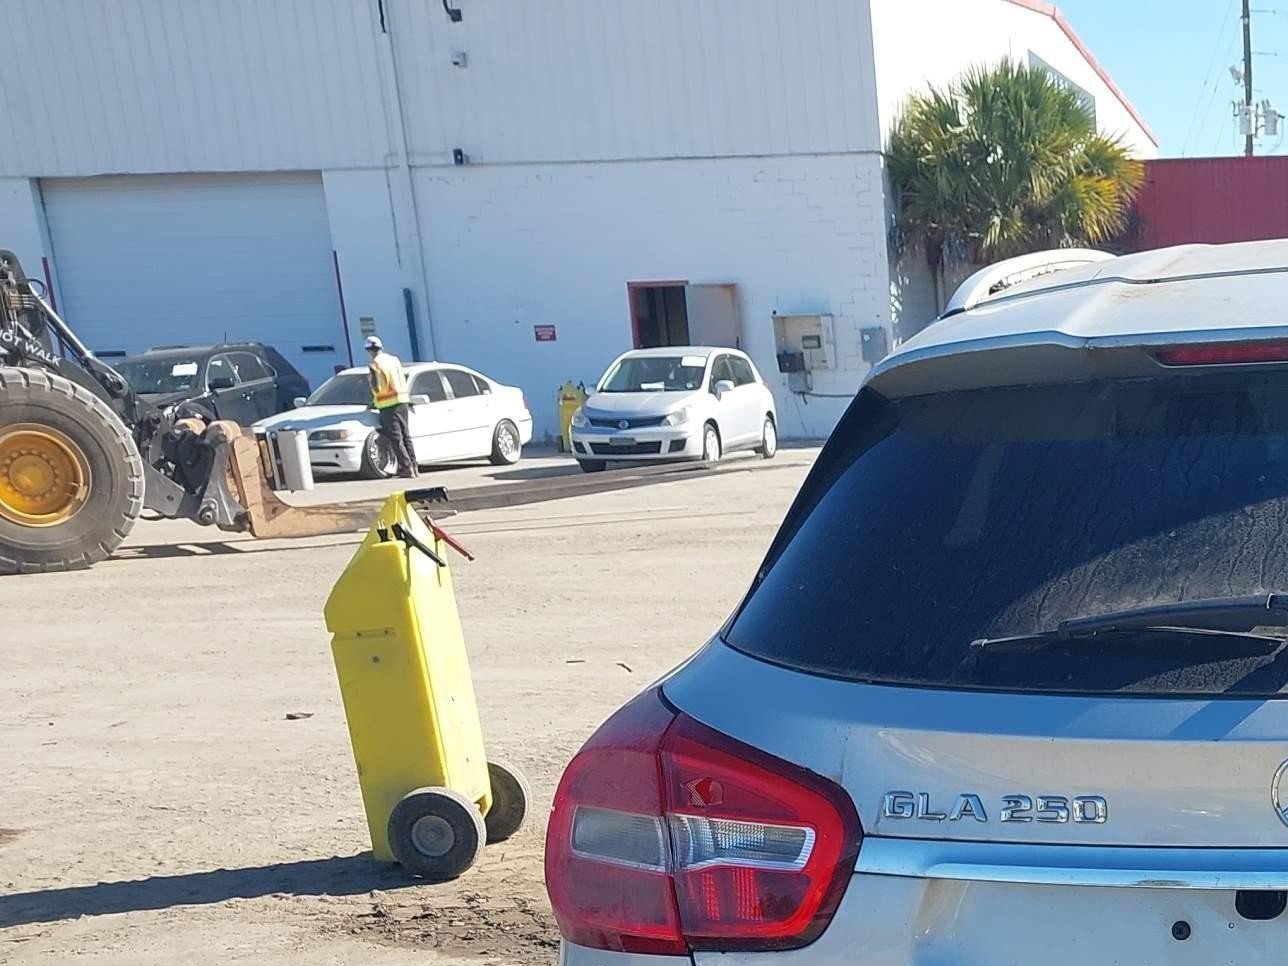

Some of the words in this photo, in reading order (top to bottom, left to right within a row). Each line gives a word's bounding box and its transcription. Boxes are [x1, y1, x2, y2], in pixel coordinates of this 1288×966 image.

[0, 329, 23, 347] OT
[25, 341, 62, 367] WALK
[884, 791, 988, 823] GLA
[1000, 794, 1108, 823] 250
